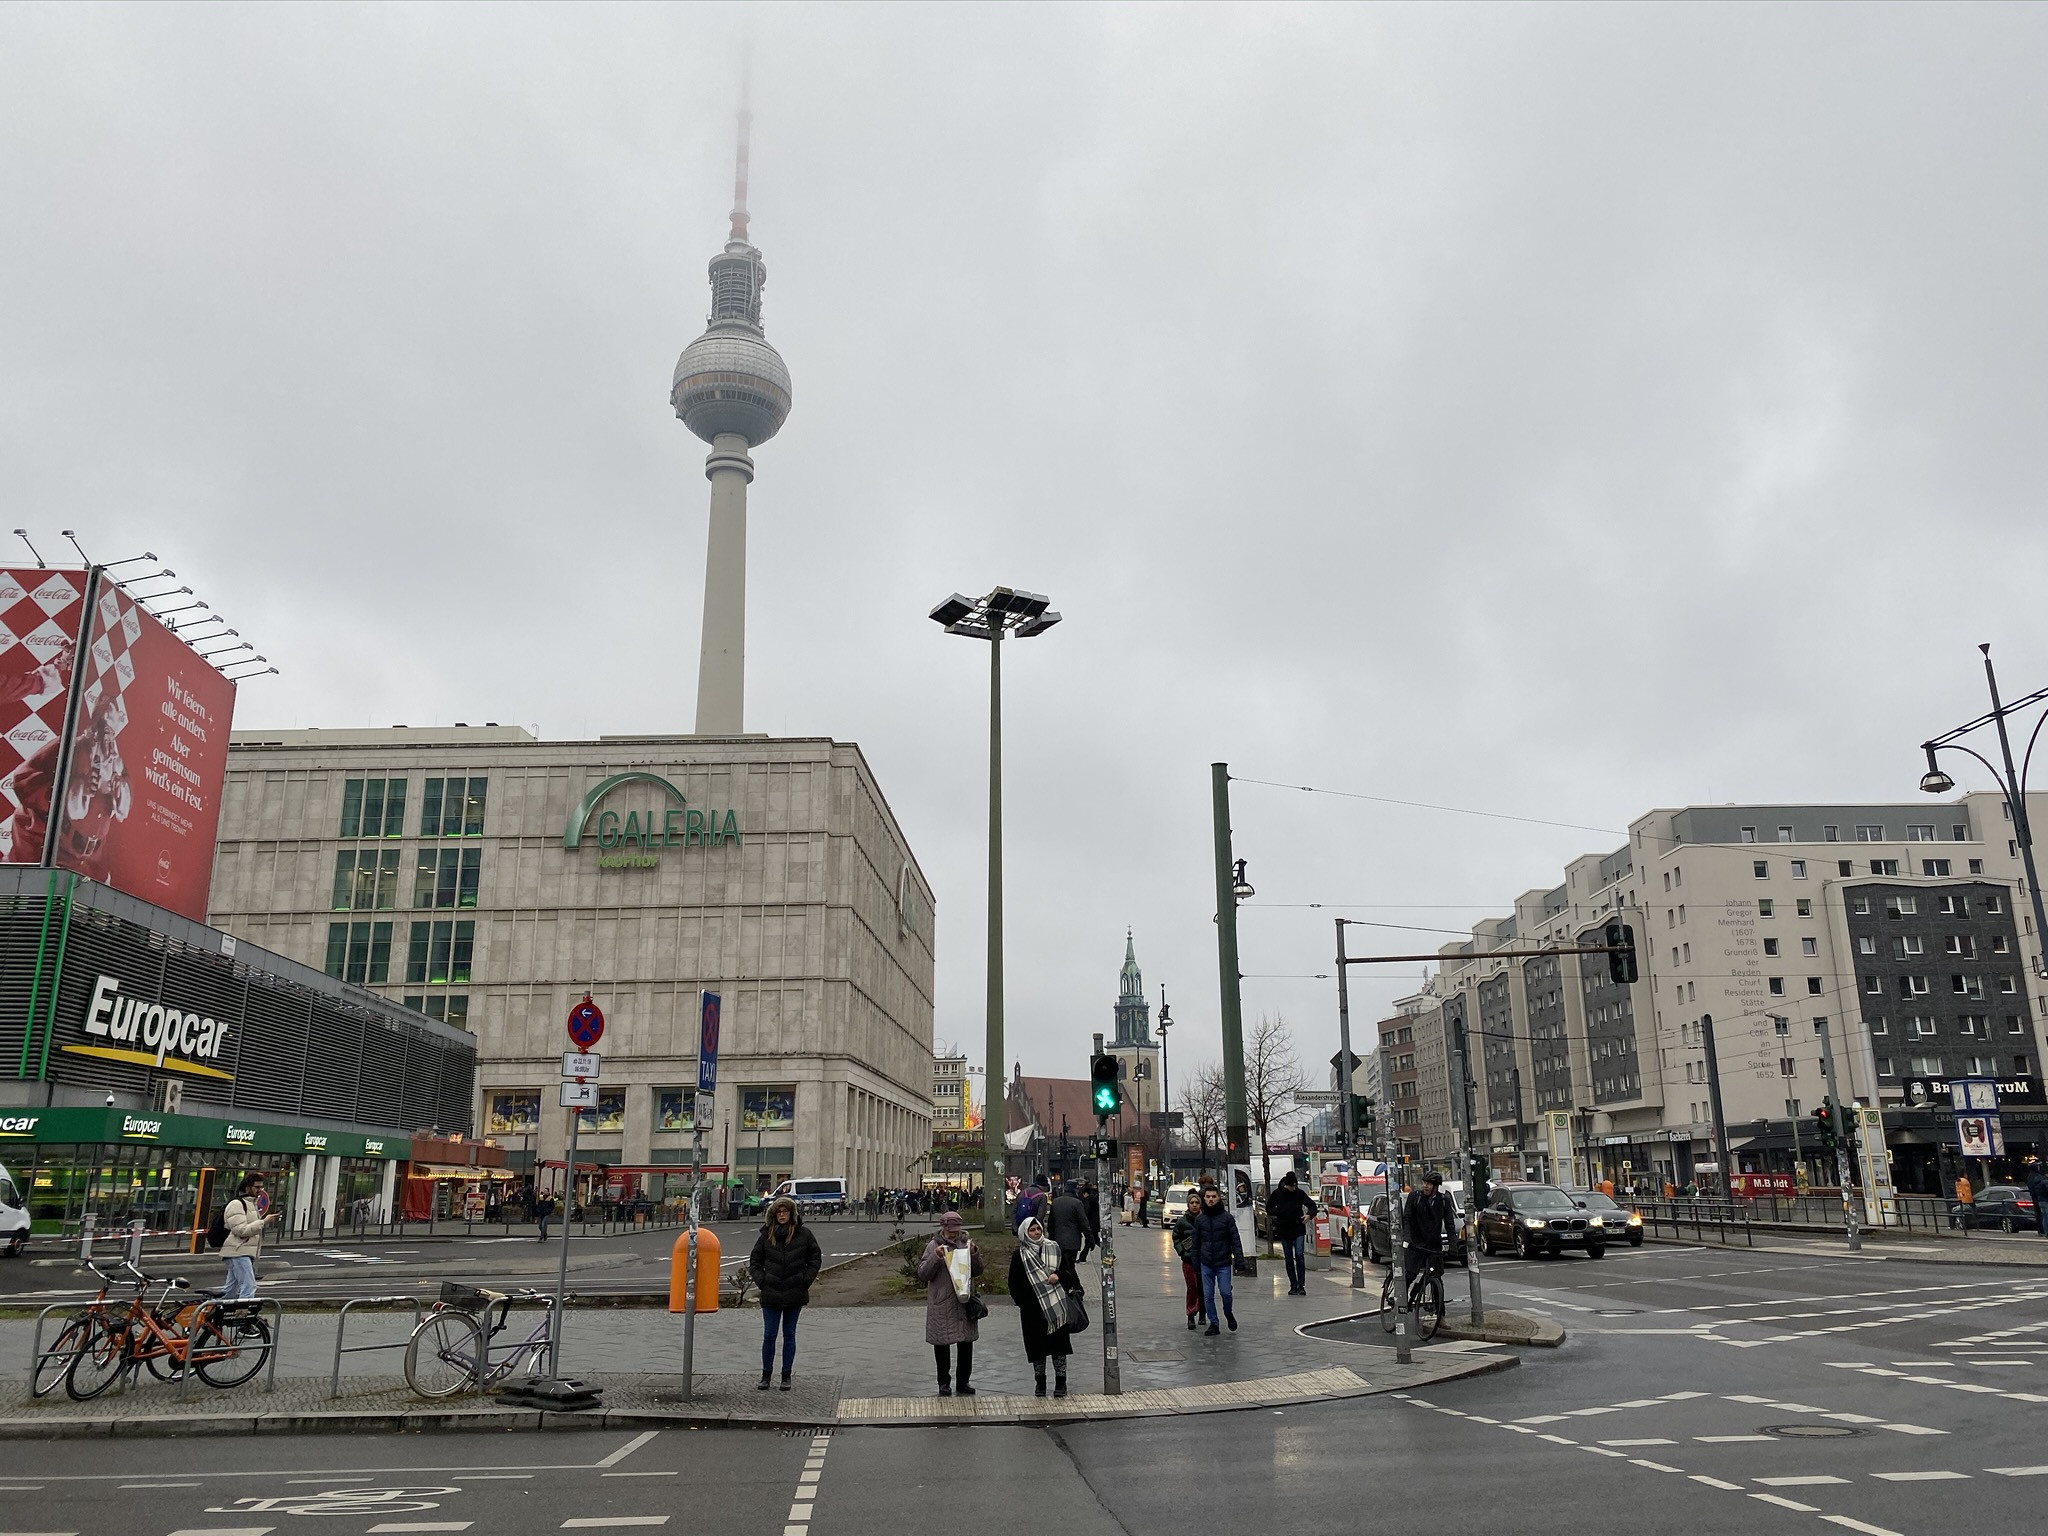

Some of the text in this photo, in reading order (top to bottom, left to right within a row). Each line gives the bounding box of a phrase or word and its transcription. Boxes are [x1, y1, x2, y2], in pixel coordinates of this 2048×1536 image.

[168, 676, 205, 719] Wir feiern
[162, 701, 206, 742] alle anders.
[170, 734, 190, 758] Aber
[152, 747, 201, 787] gemeinsam
[171, 780, 184, 800] ein
[185, 787, 202, 811] Fest.
[597, 809, 741, 849] GALERIA
[1726, 908, 1752, 917] Gregor
[1724, 948, 1758, 956] Grundriß
[1731, 968, 1761, 977] Beyden
[85, 975, 228, 1067] Europcar
[701, 1060, 715, 1082] TAXI
[1756, 1071, 1775, 1079] 1652
[1295, 1094, 1340, 1103] Alexanderstraße
[123, 1115, 162, 1137] Europcar
[226, 1125, 256, 1144] Europcar
[304, 1132, 328, 1148] Europcar
[365, 1138, 384, 1151] Europcar
[1753, 1178, 1789, 1188] M.Bldt
